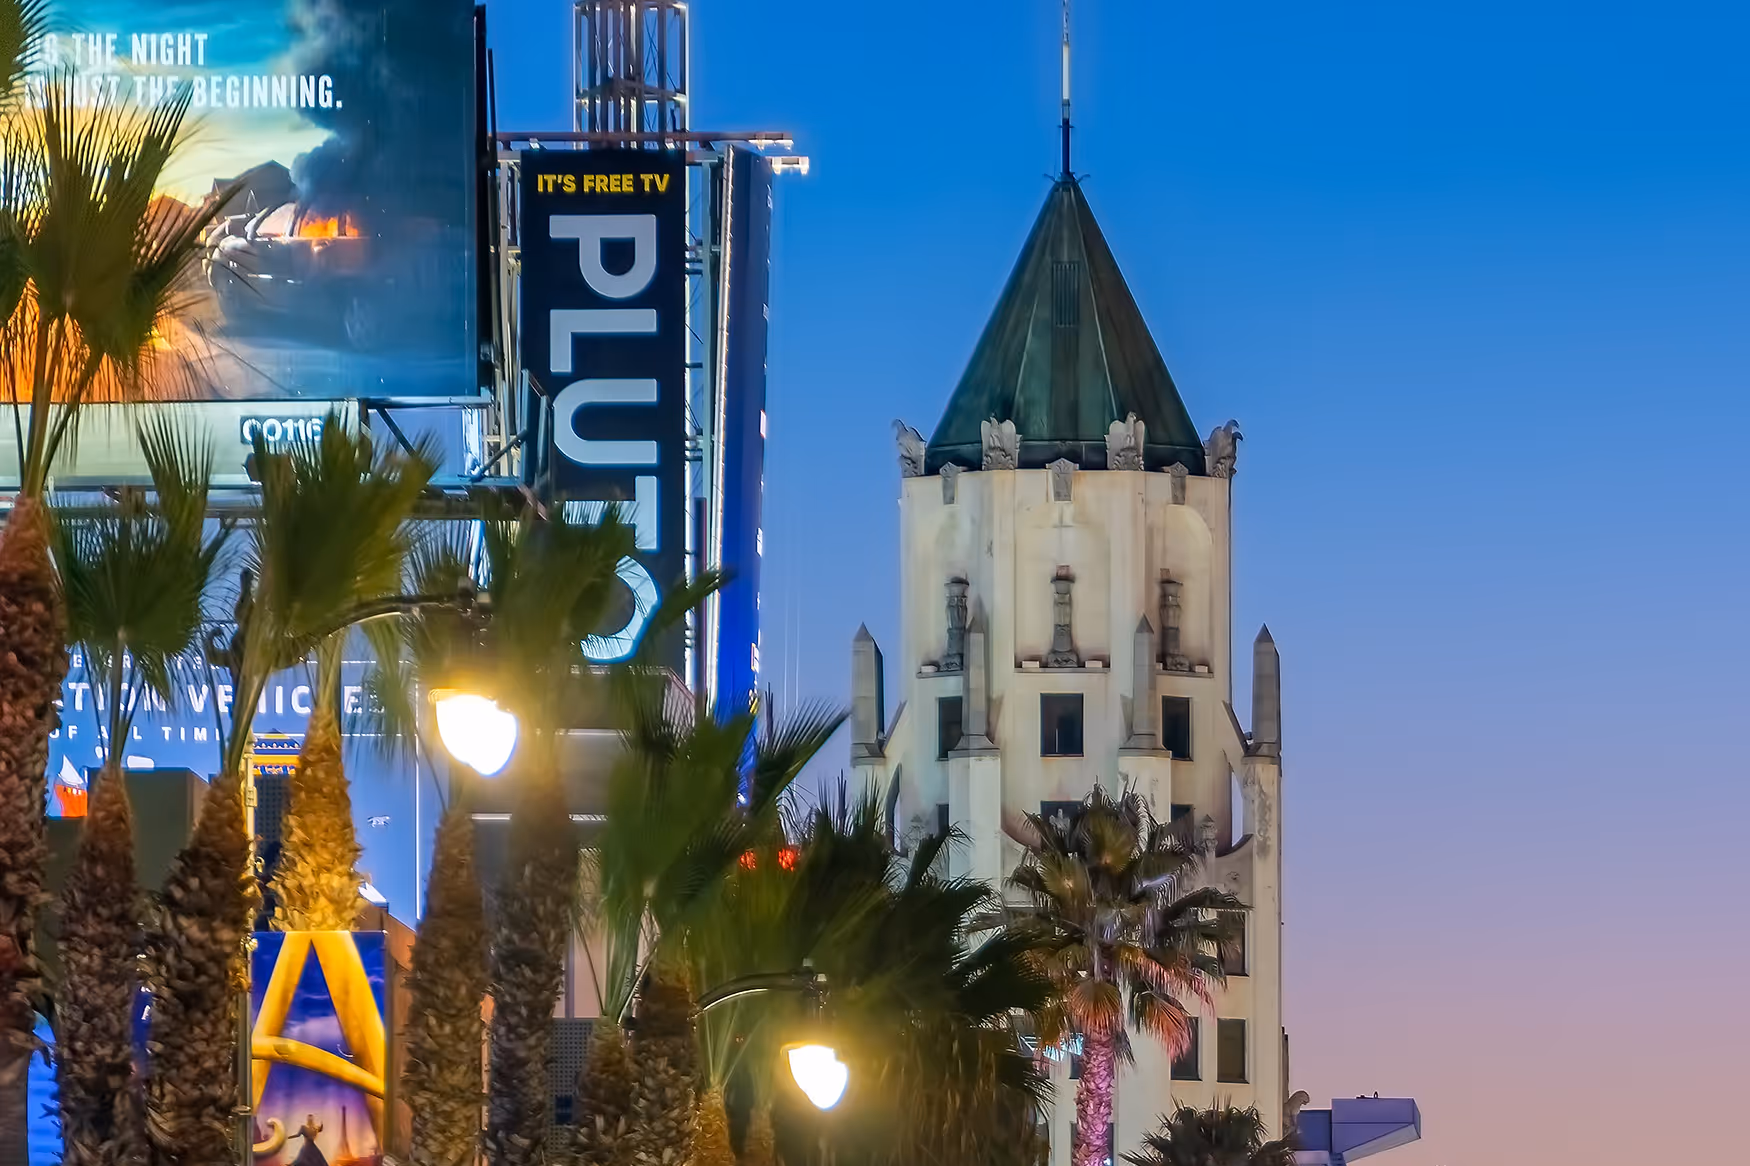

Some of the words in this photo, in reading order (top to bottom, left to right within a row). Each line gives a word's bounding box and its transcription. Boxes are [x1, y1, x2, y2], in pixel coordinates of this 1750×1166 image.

[71, 32, 118, 66] THE
[132, 32, 209, 66] NIGHT
[133, 75, 179, 109] THE
[193, 74, 344, 109] BEGINNING.
[537, 173, 577, 194] IT'S
[583, 173, 635, 194] FREE
[641, 173, 671, 193] TV
[162, 726, 220, 741] TIM
